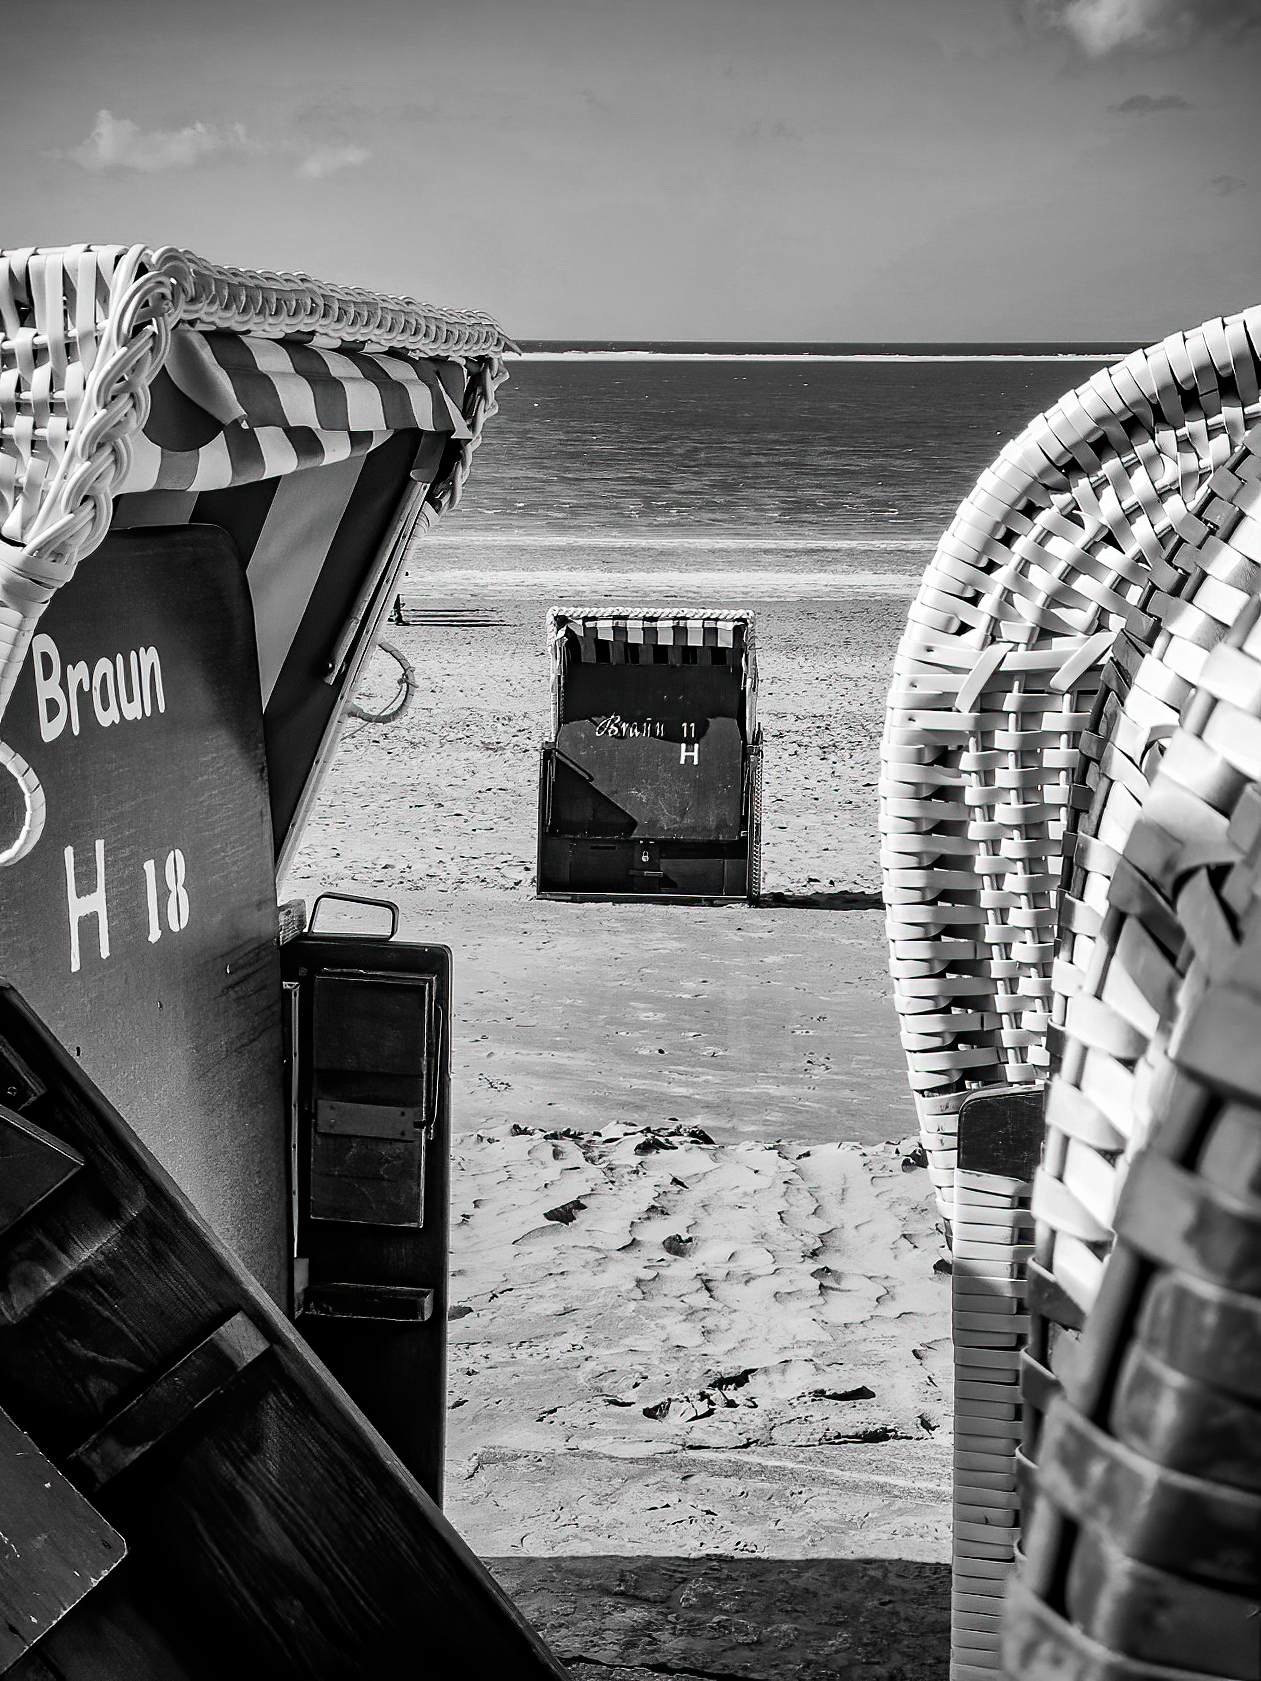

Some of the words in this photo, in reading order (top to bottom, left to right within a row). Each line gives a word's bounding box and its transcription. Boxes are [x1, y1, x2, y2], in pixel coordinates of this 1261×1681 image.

[32, 633, 165, 742] Braun
[679, 743, 700, 766] H
[681, 722, 696, 738] 11
[64, 839, 110, 973] H
[143, 848, 190, 943] 18
